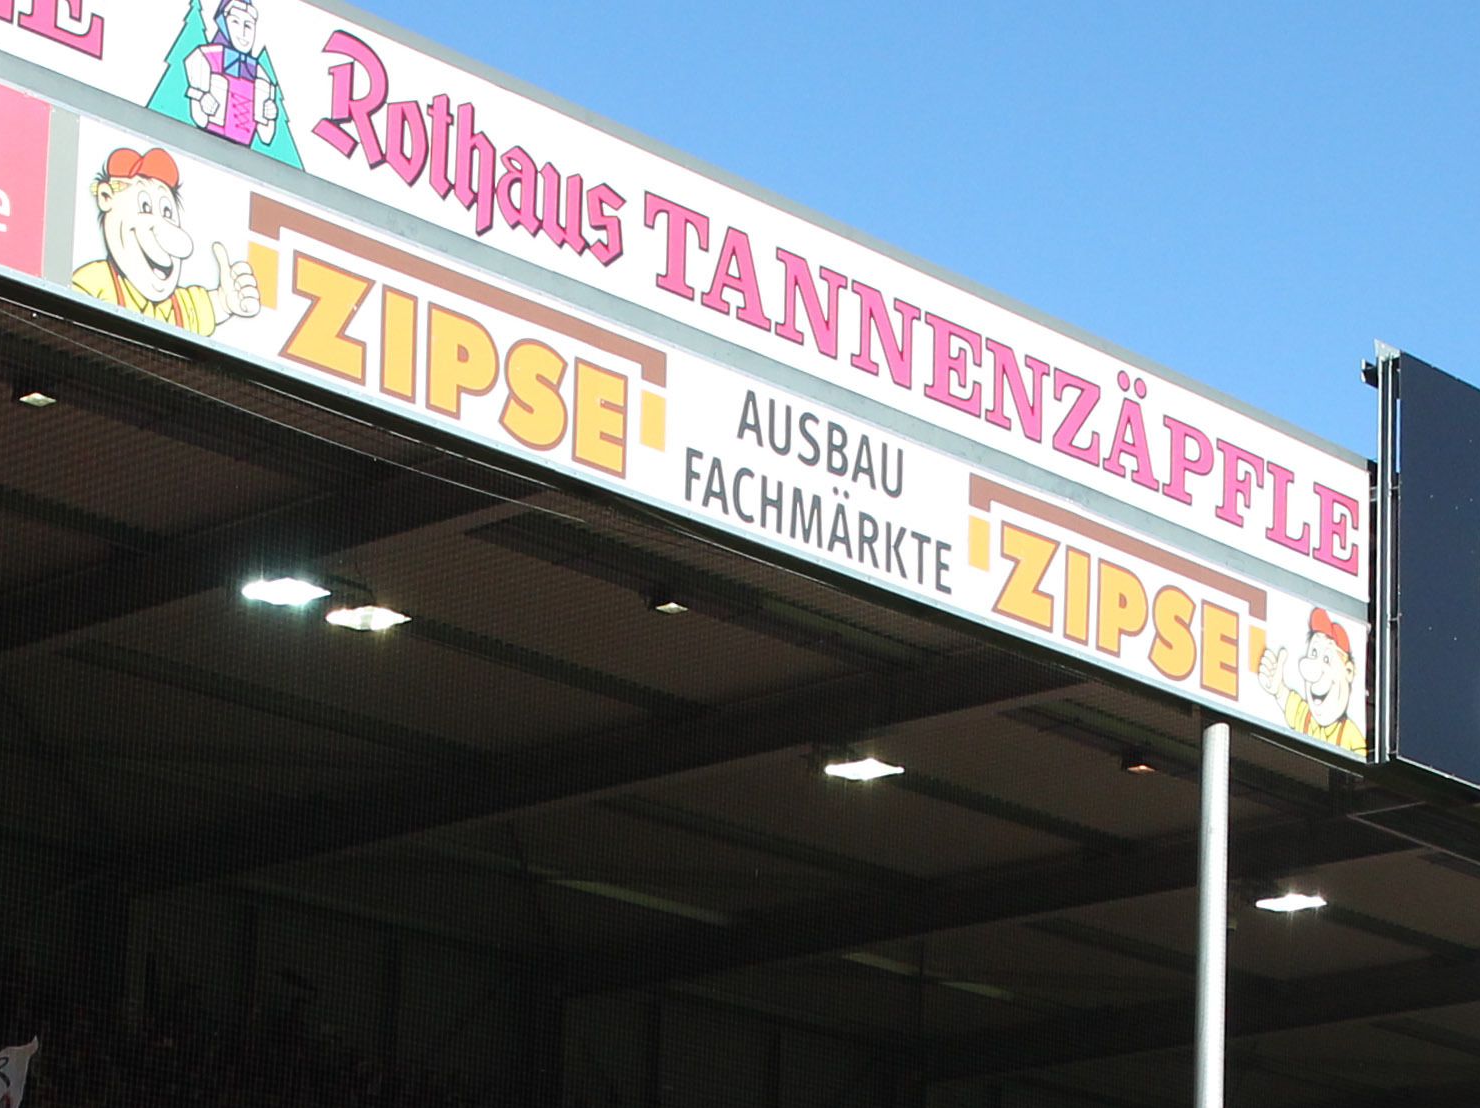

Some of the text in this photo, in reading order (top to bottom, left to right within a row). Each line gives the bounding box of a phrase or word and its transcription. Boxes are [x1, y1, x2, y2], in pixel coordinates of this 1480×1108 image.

[278, 249, 629, 479] ZIPSE
[312, 29, 1360, 577] Rothaus TANNENZÄPFLE
[684, 448, 953, 595] FACHMÄRKTE
[737, 389, 905, 498] AUSBAU
[992, 521, 1240, 702] ZIPSE
